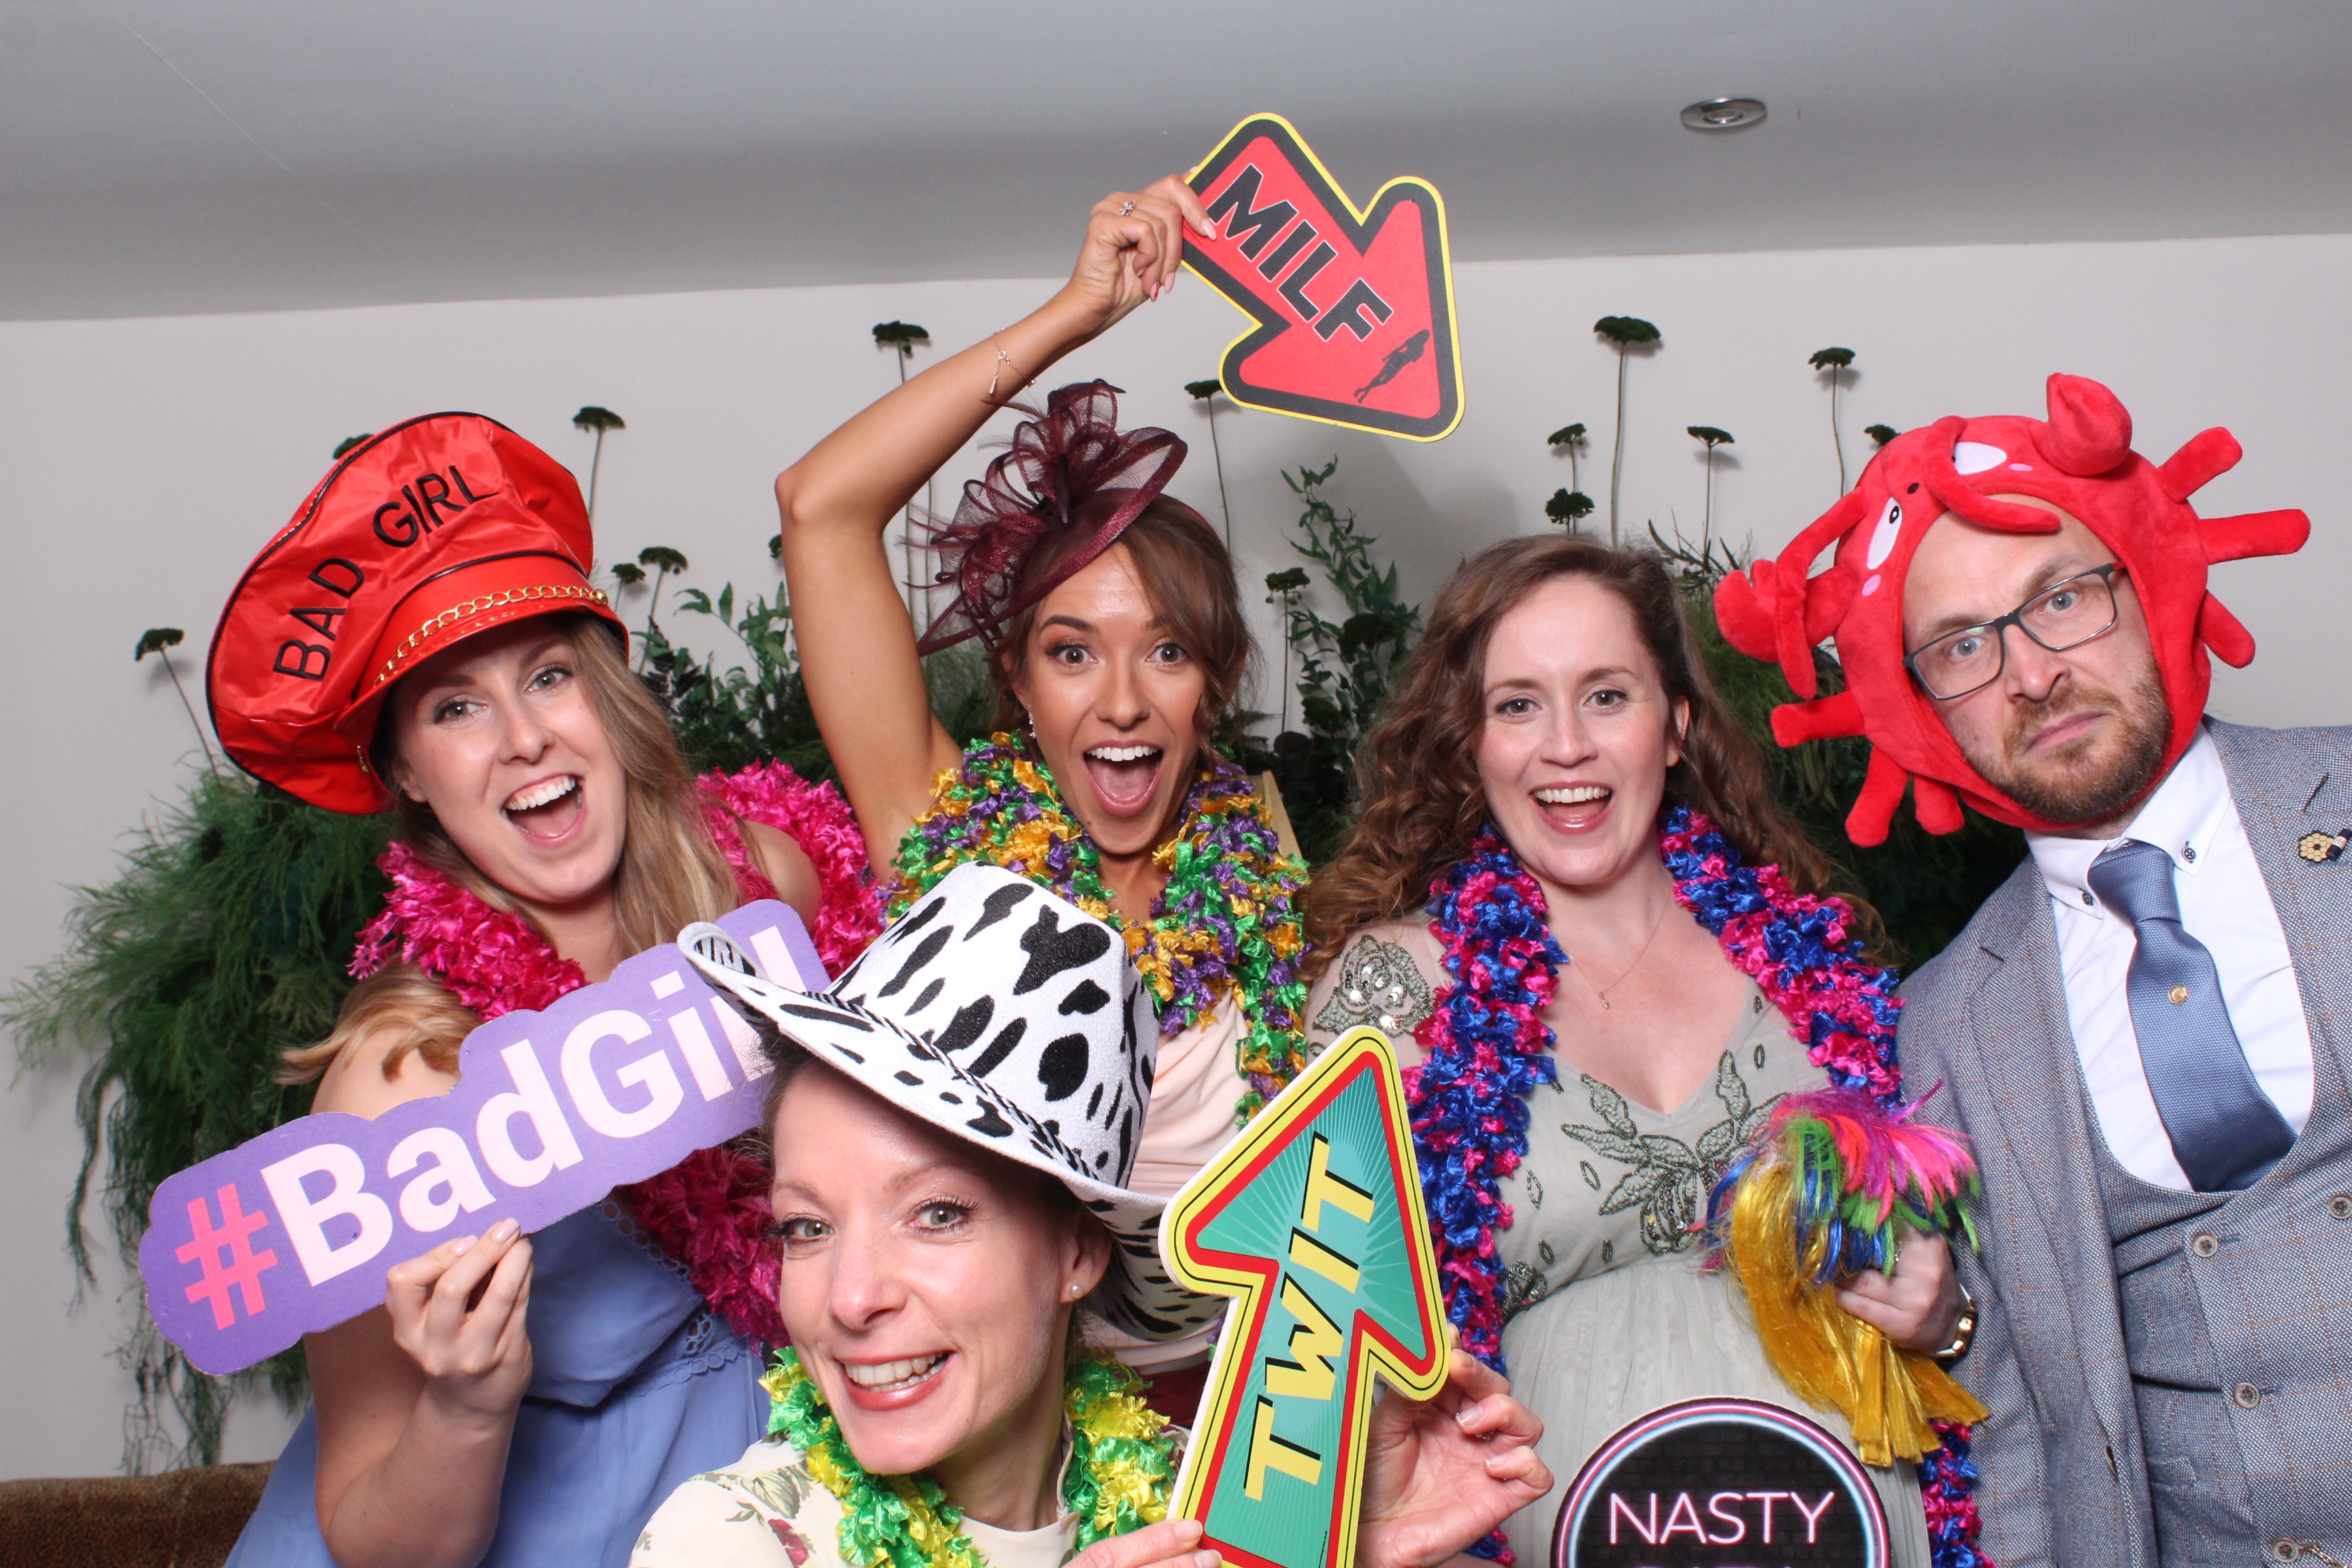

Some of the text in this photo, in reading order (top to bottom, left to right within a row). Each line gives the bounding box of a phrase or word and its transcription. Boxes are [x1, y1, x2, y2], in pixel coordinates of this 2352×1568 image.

[1206, 163, 1394, 342] MILF
[274, 466, 500, 681] BAD GIRL
[1244, 1131, 1375, 1501] TWIT
[1609, 1491, 1835, 1545] NASTY
